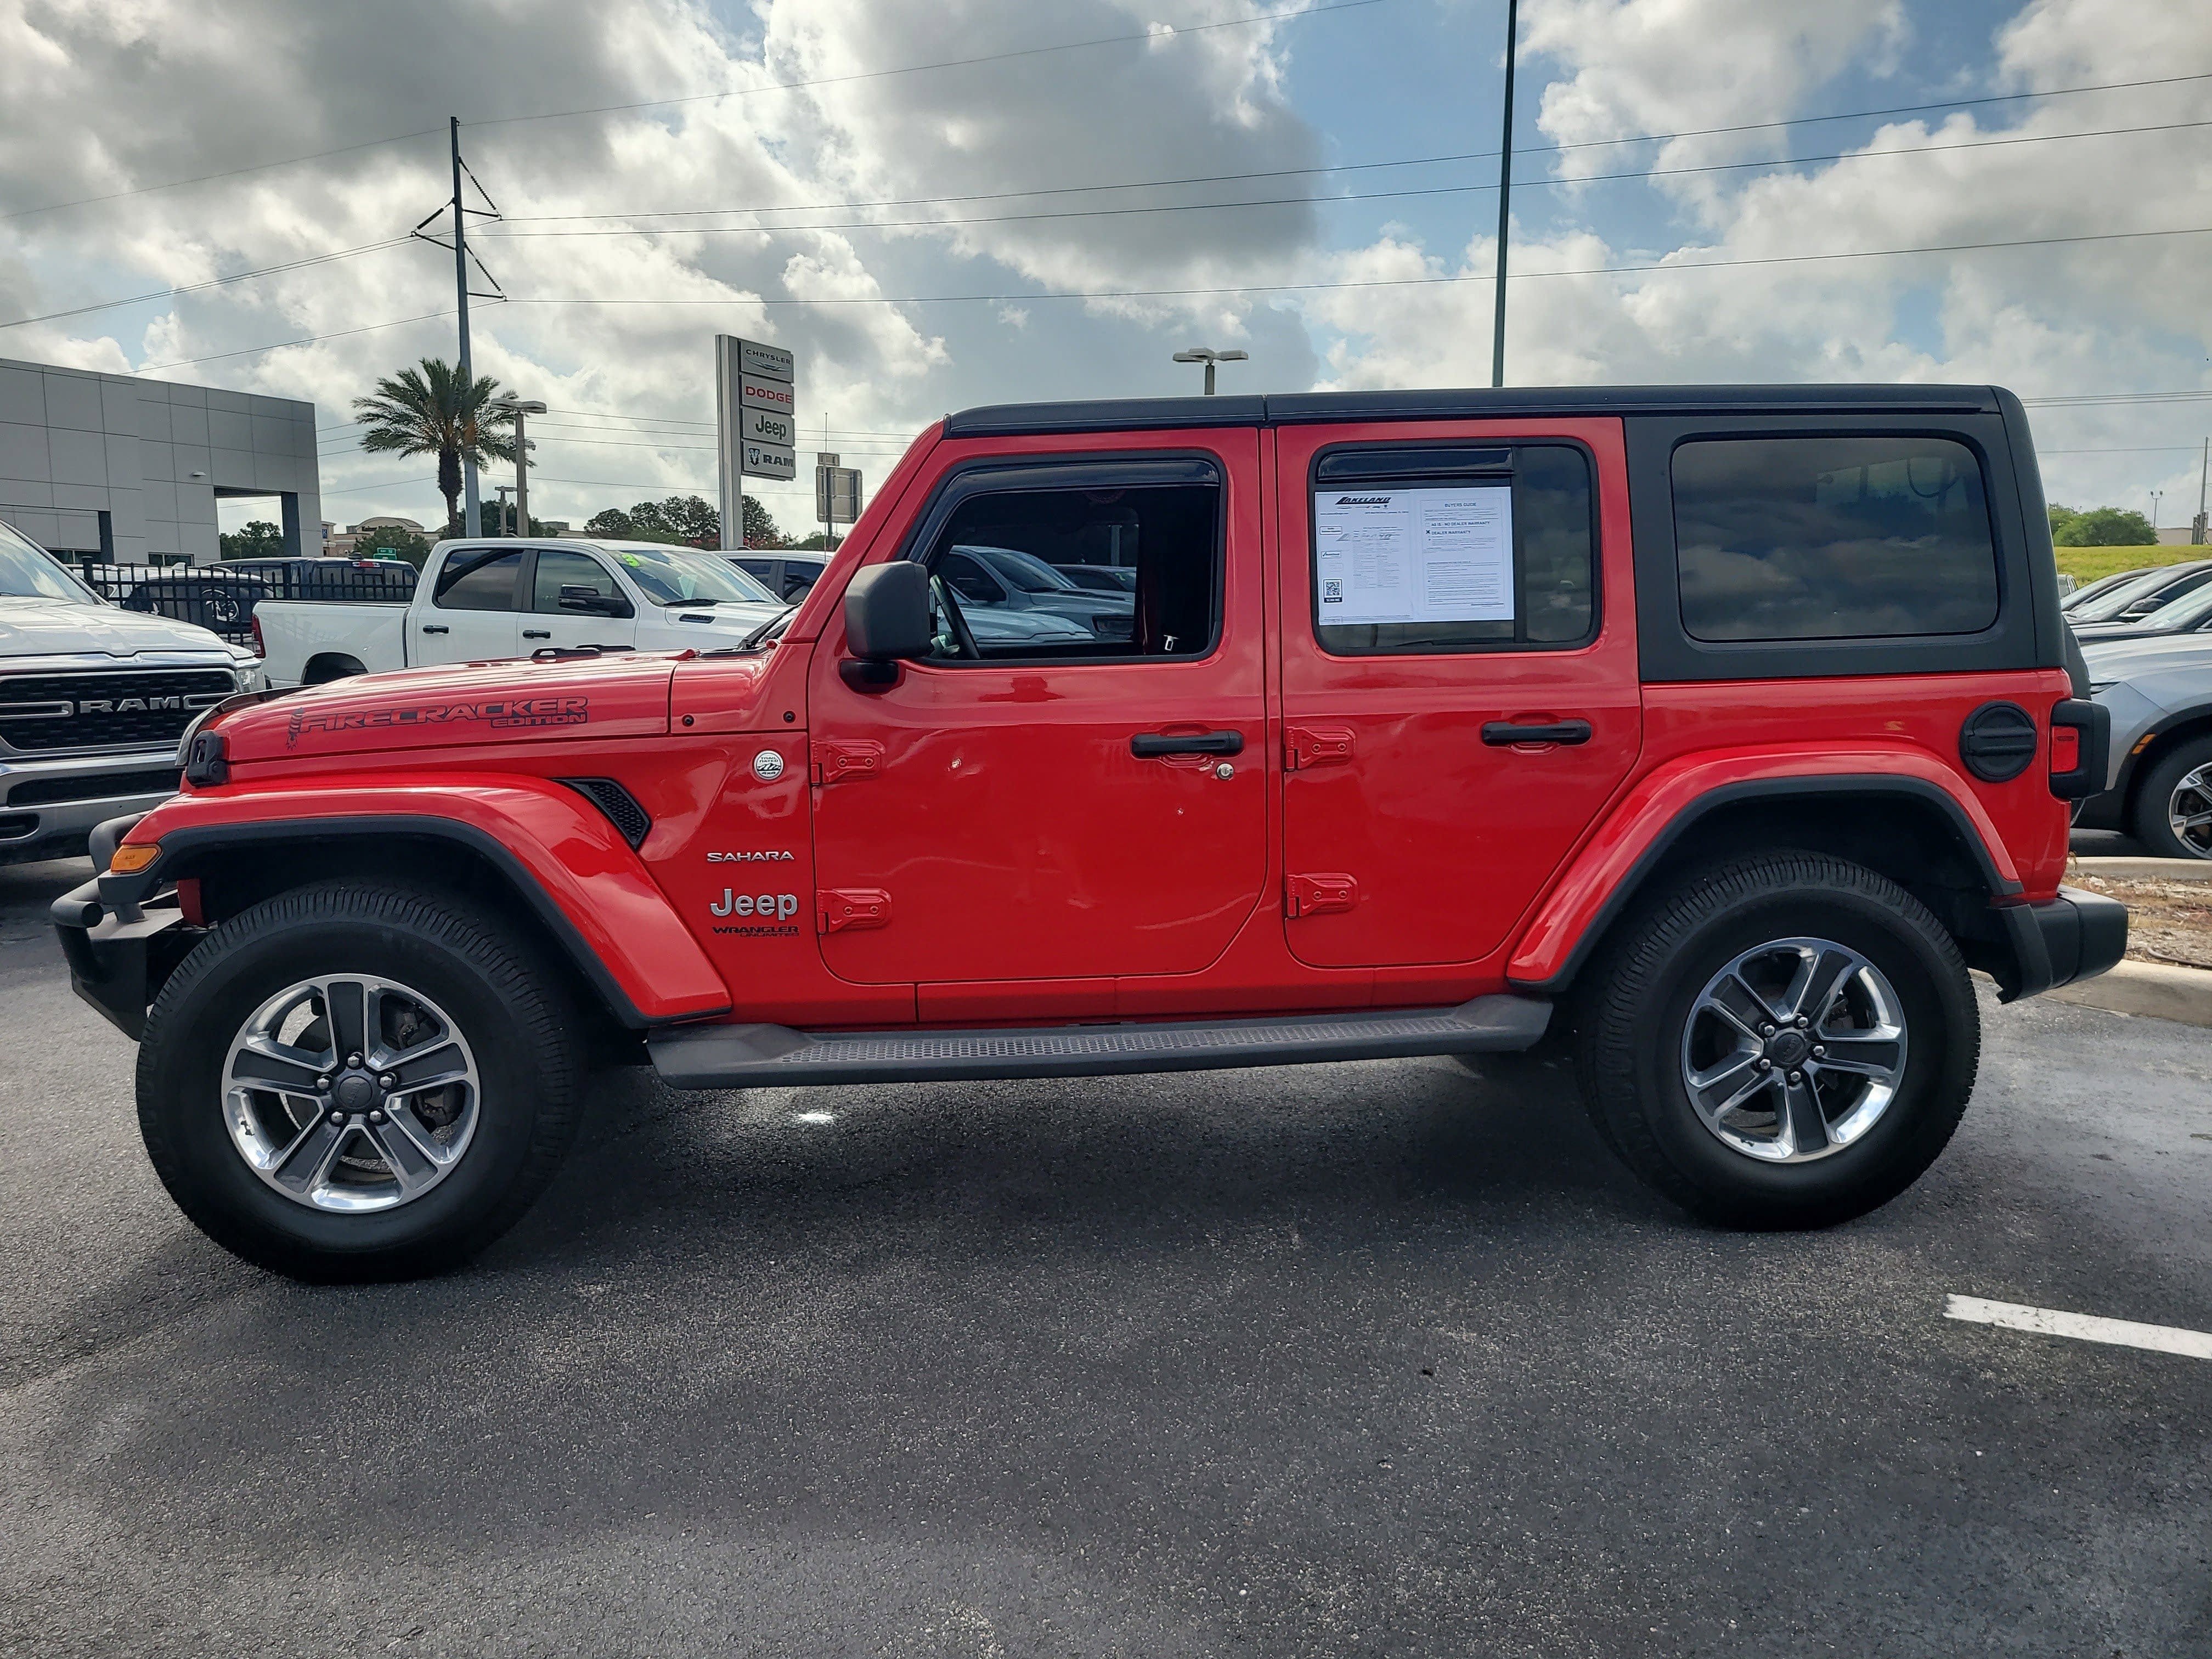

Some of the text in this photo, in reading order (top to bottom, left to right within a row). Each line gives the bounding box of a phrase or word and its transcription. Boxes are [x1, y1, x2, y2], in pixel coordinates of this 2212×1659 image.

[746, 348, 791, 365] CHRYSLER
[746, 385, 792, 404] DODGE
[755, 414, 787, 439] Jeep
[763, 453, 794, 468] RAM
[1334, 496, 1392, 505] LAKELAND
[79, 695, 181, 714] RAM
[300, 697, 588, 733] FIRECRACKER
[492, 714, 587, 727] EDITION
[707, 851, 795, 863] SAHARA
[710, 888, 798, 921] Jeep
